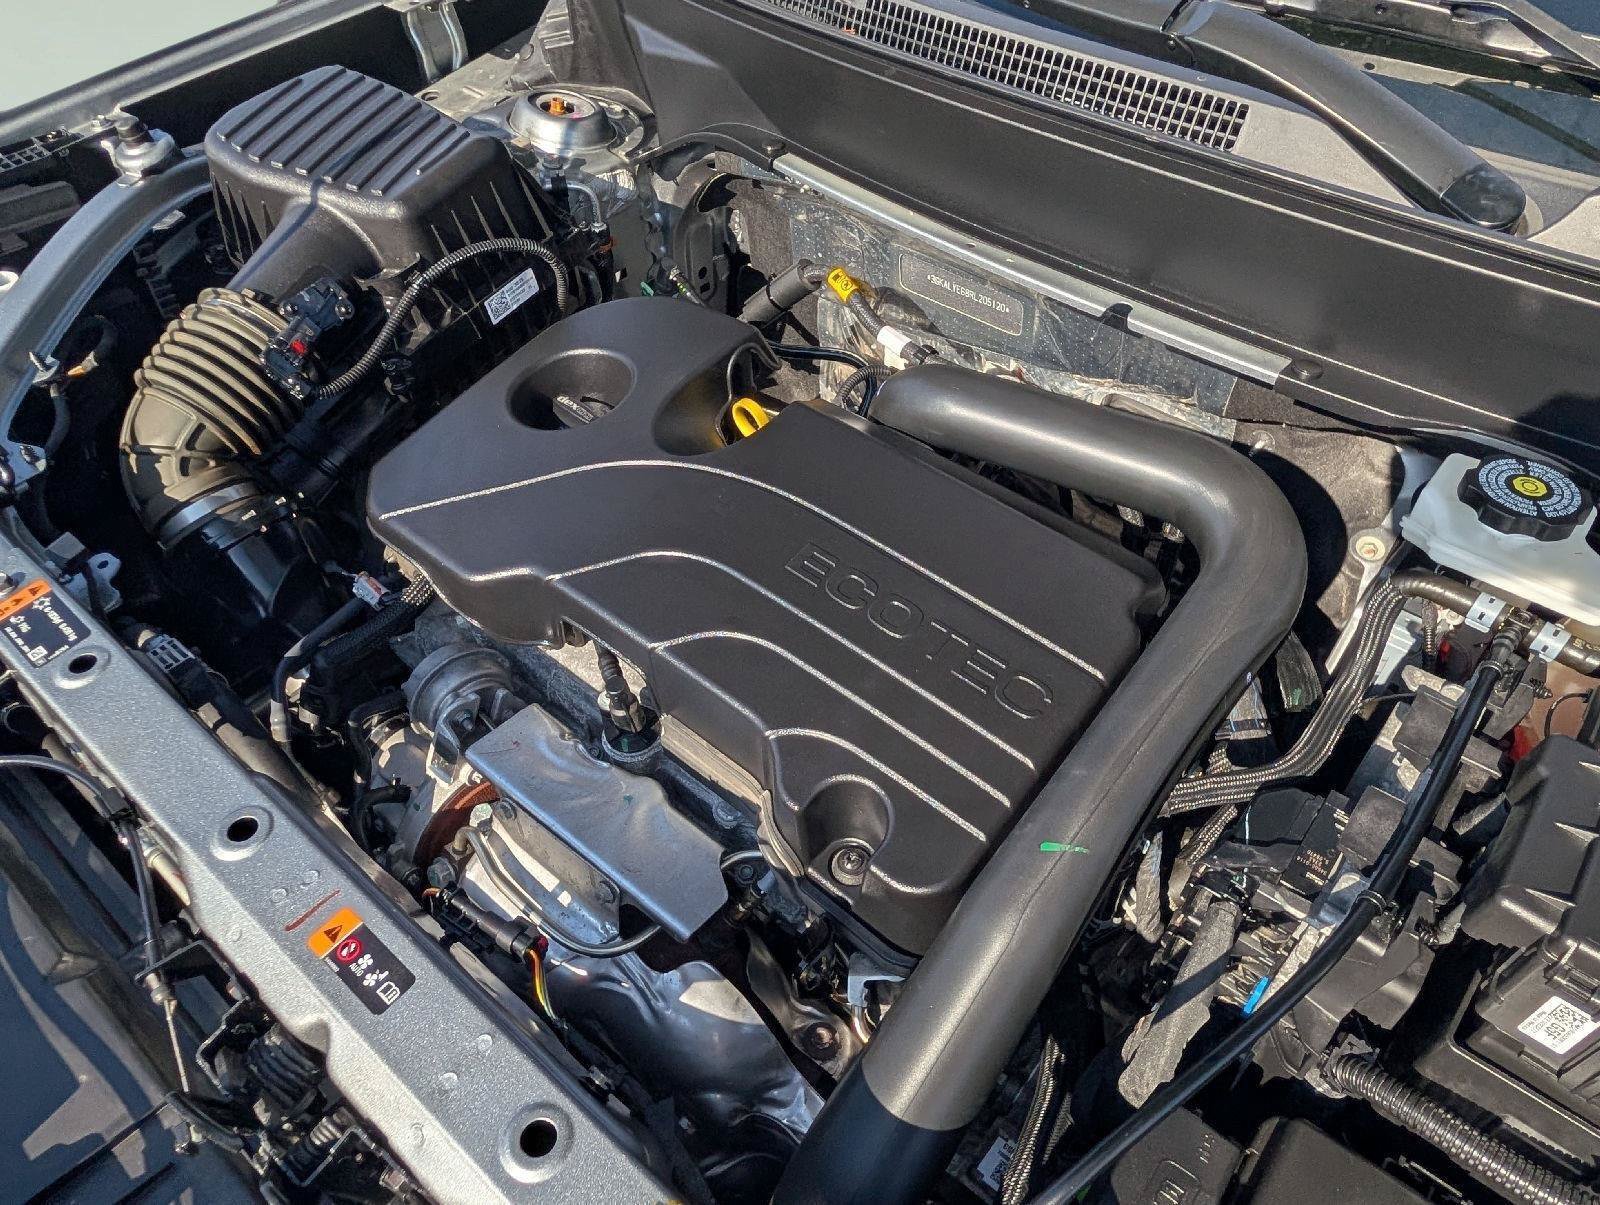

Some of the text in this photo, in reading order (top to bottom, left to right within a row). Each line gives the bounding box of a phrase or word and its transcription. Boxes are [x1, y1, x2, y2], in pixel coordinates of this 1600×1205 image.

[785, 541, 1054, 720] ECOTEC
[349, 962, 364, 976] AUTO
[1545, 1022, 1566, 1040] G5F
